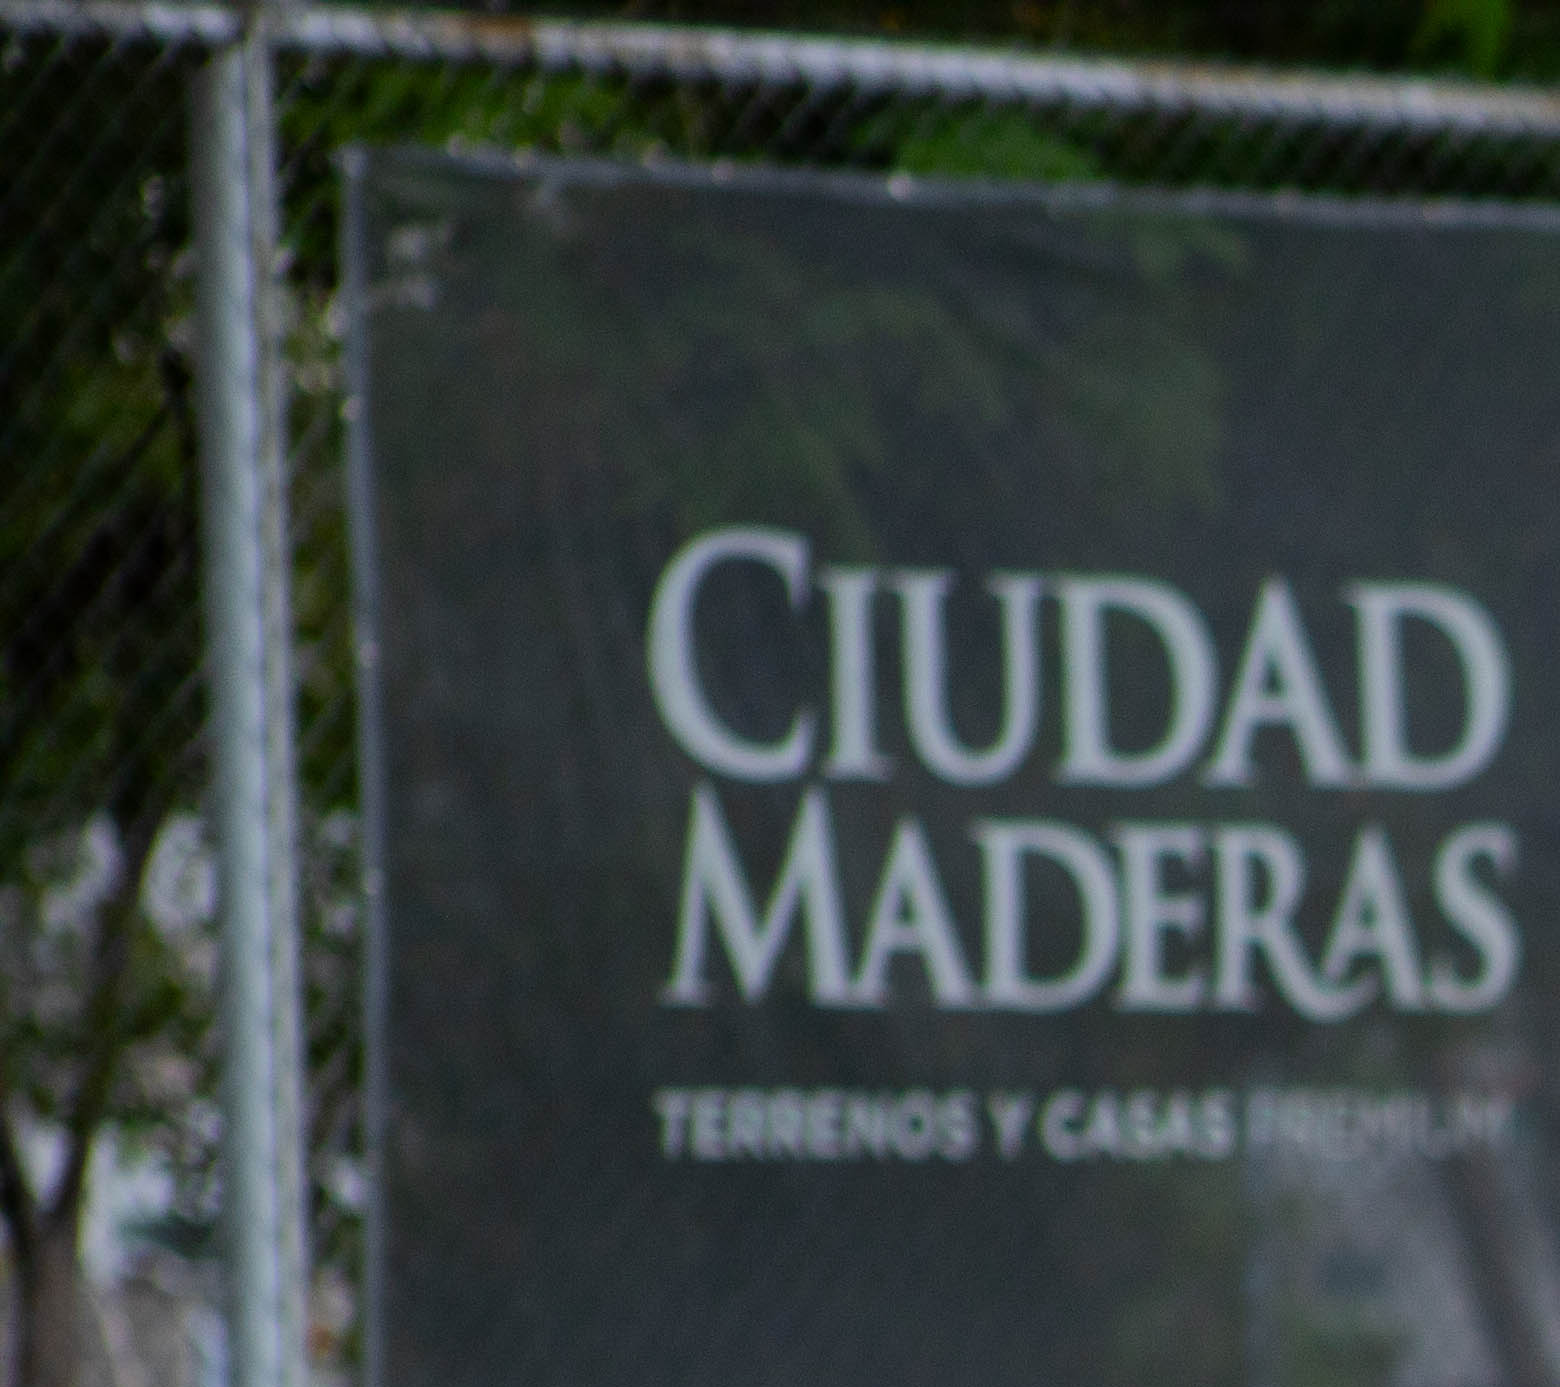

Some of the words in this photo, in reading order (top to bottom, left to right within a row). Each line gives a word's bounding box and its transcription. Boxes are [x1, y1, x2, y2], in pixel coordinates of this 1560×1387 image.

[646, 525, 1514, 790] CIUDAD
[661, 780, 1522, 1022] MADERAS
[653, 1088, 977, 1162] TERRENOS
[990, 1090, 1034, 1160] Y
[1039, 1088, 1238, 1162] CASAS
[1246, 1090, 1516, 1160] PREMIUM
